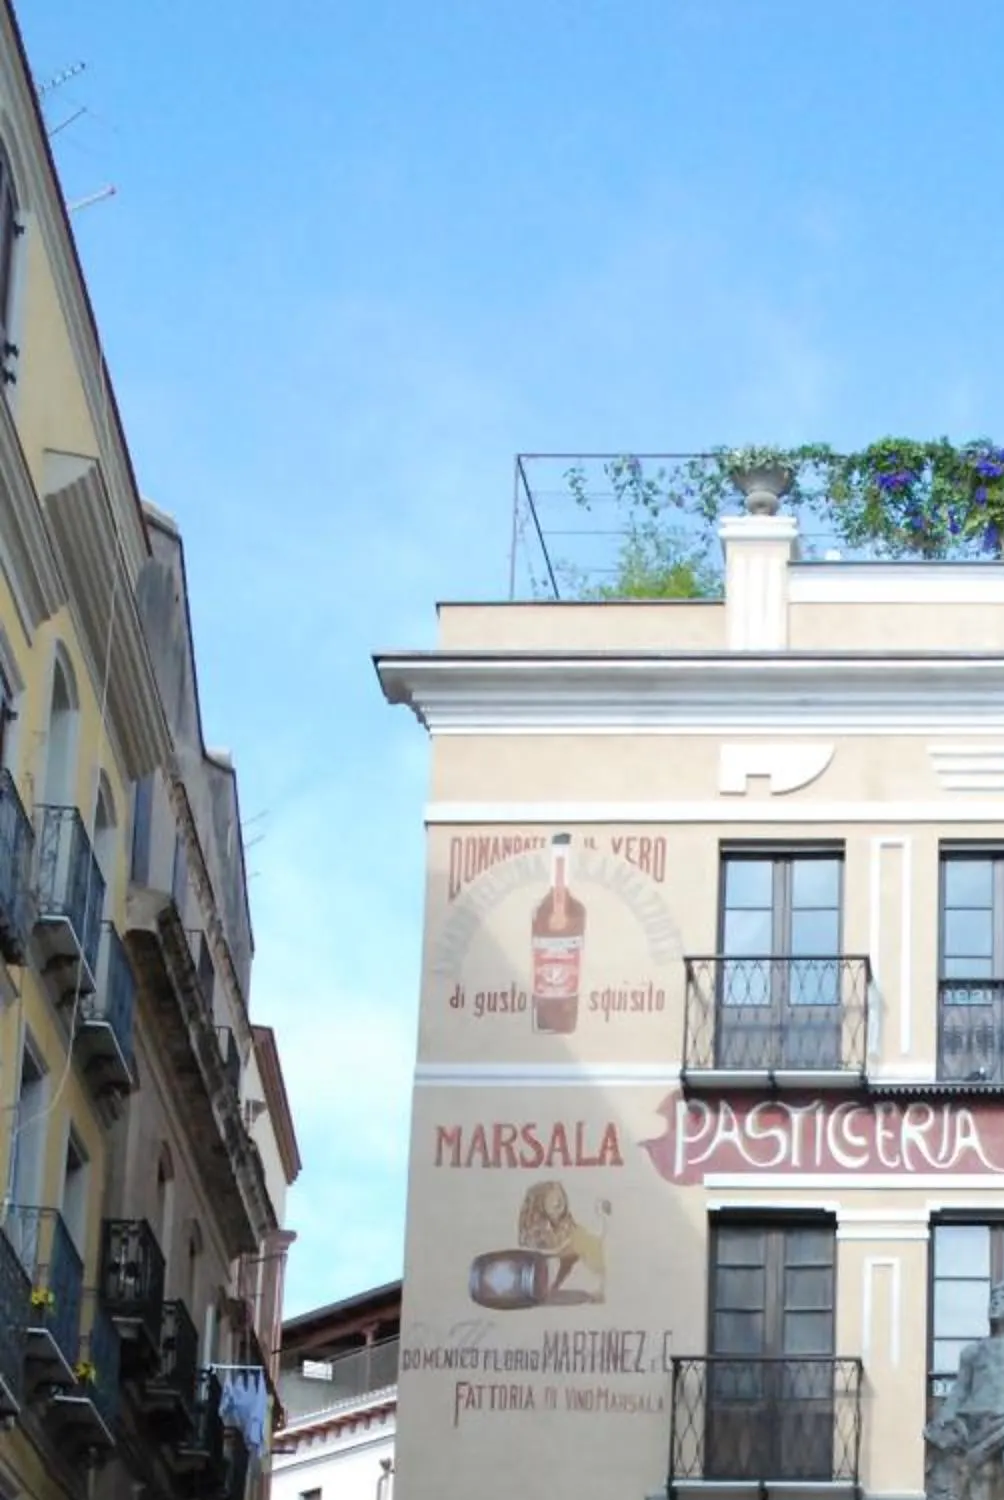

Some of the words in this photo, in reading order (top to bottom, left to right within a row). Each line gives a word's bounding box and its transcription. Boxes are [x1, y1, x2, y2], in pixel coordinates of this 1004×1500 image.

[584, 838, 598, 850] IL
[612, 836, 667, 883] VERO
[449, 984, 465, 1009] di
[474, 982, 527, 1018] gusto
[589, 981, 666, 1022] squisito
[433, 1122, 624, 1169] MARSALA
[403, 1347, 479, 1372] DOMENICO
[541, 1329, 646, 1373] MARTINEZ
[455, 1381, 535, 1428] FATTORIA
